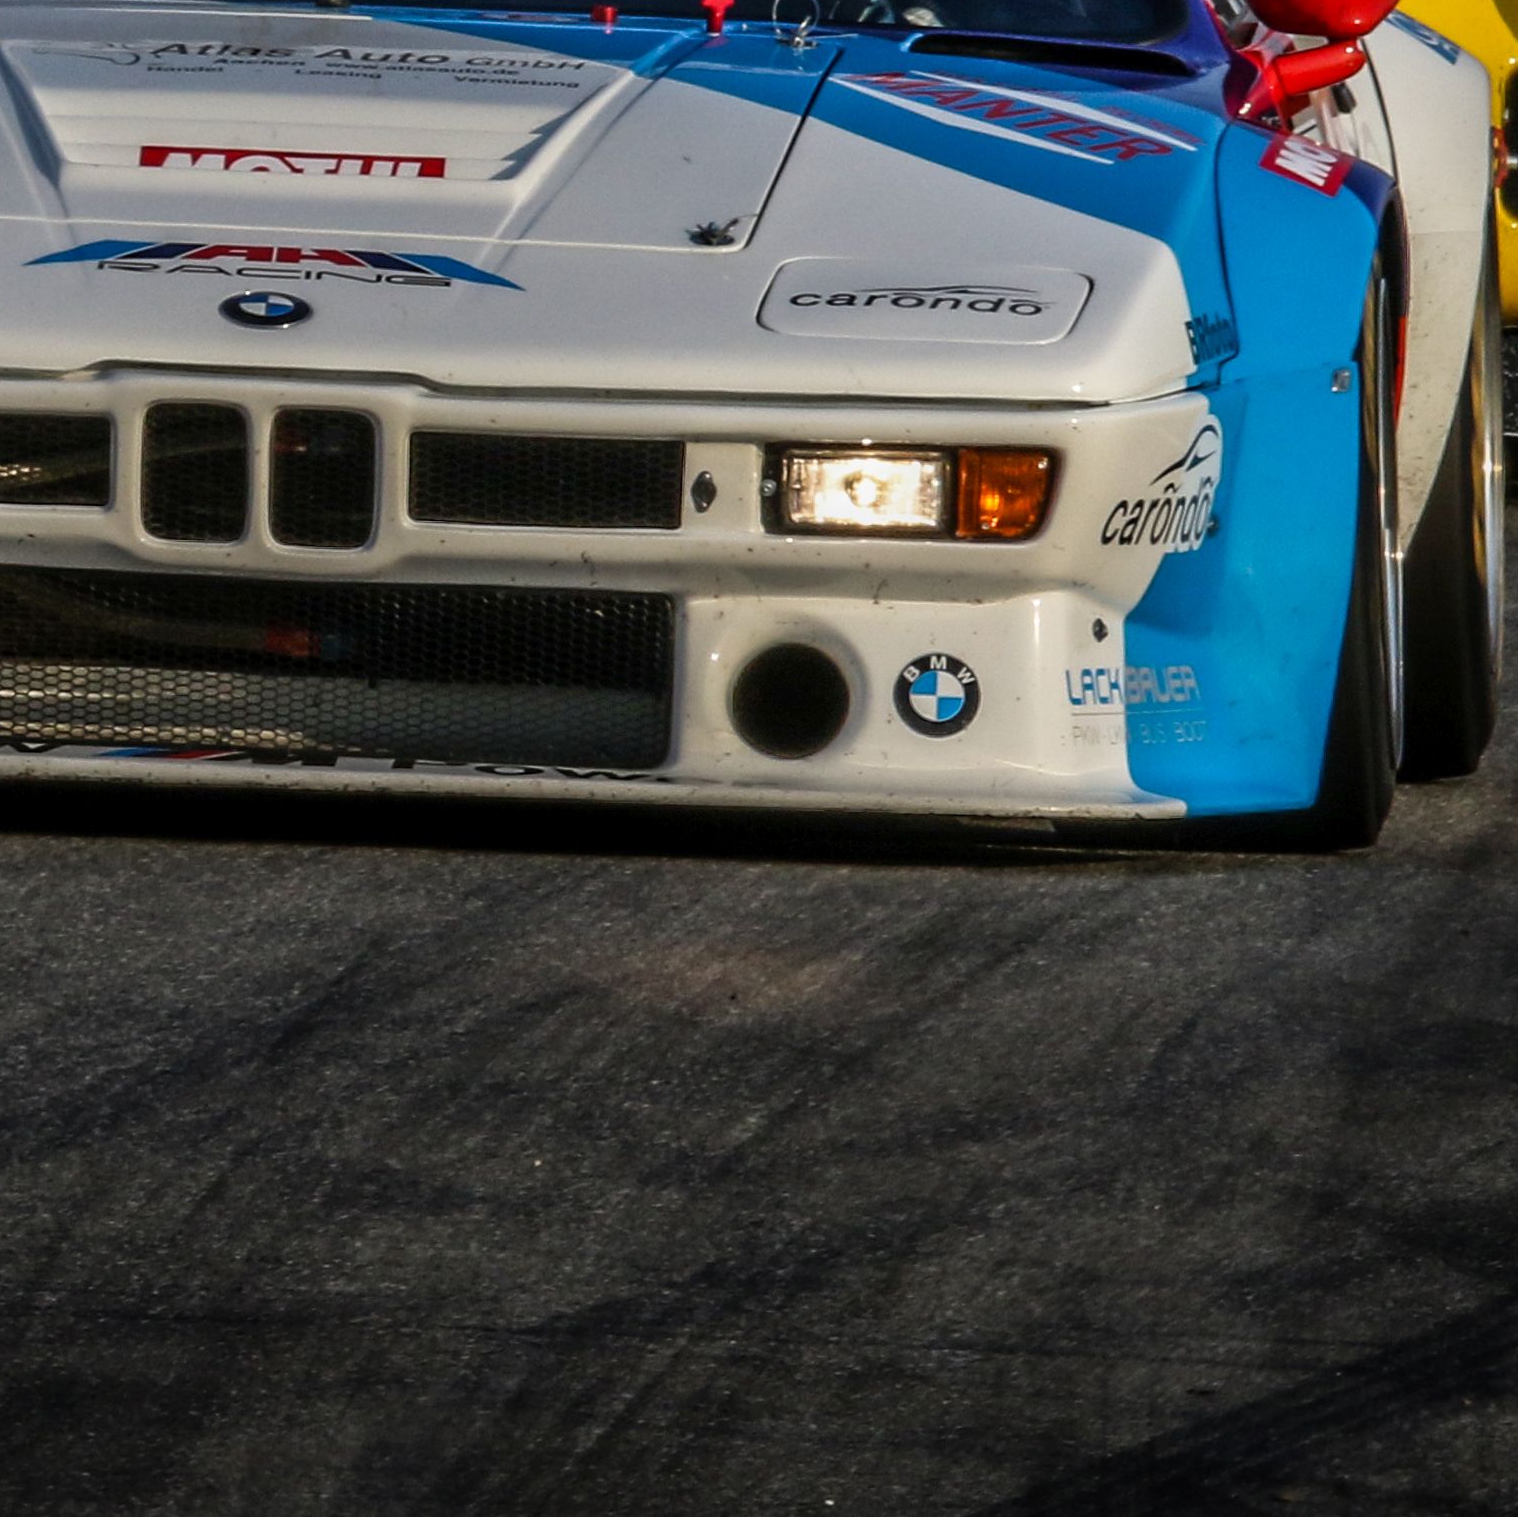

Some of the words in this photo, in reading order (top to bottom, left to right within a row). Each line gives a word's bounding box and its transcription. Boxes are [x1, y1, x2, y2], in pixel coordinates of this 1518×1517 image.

[150, 42, 297, 60] Atlas
[314, 47, 451, 65] Auto
[465, 56, 587, 71] GmbH
[295, 69, 384, 80] Leasing
[454, 75, 581, 89] Vermietung
[96, 260, 452, 288] RACING
[788, 289, 1046, 316] carondo
[1099, 474, 1217, 551] carondo
